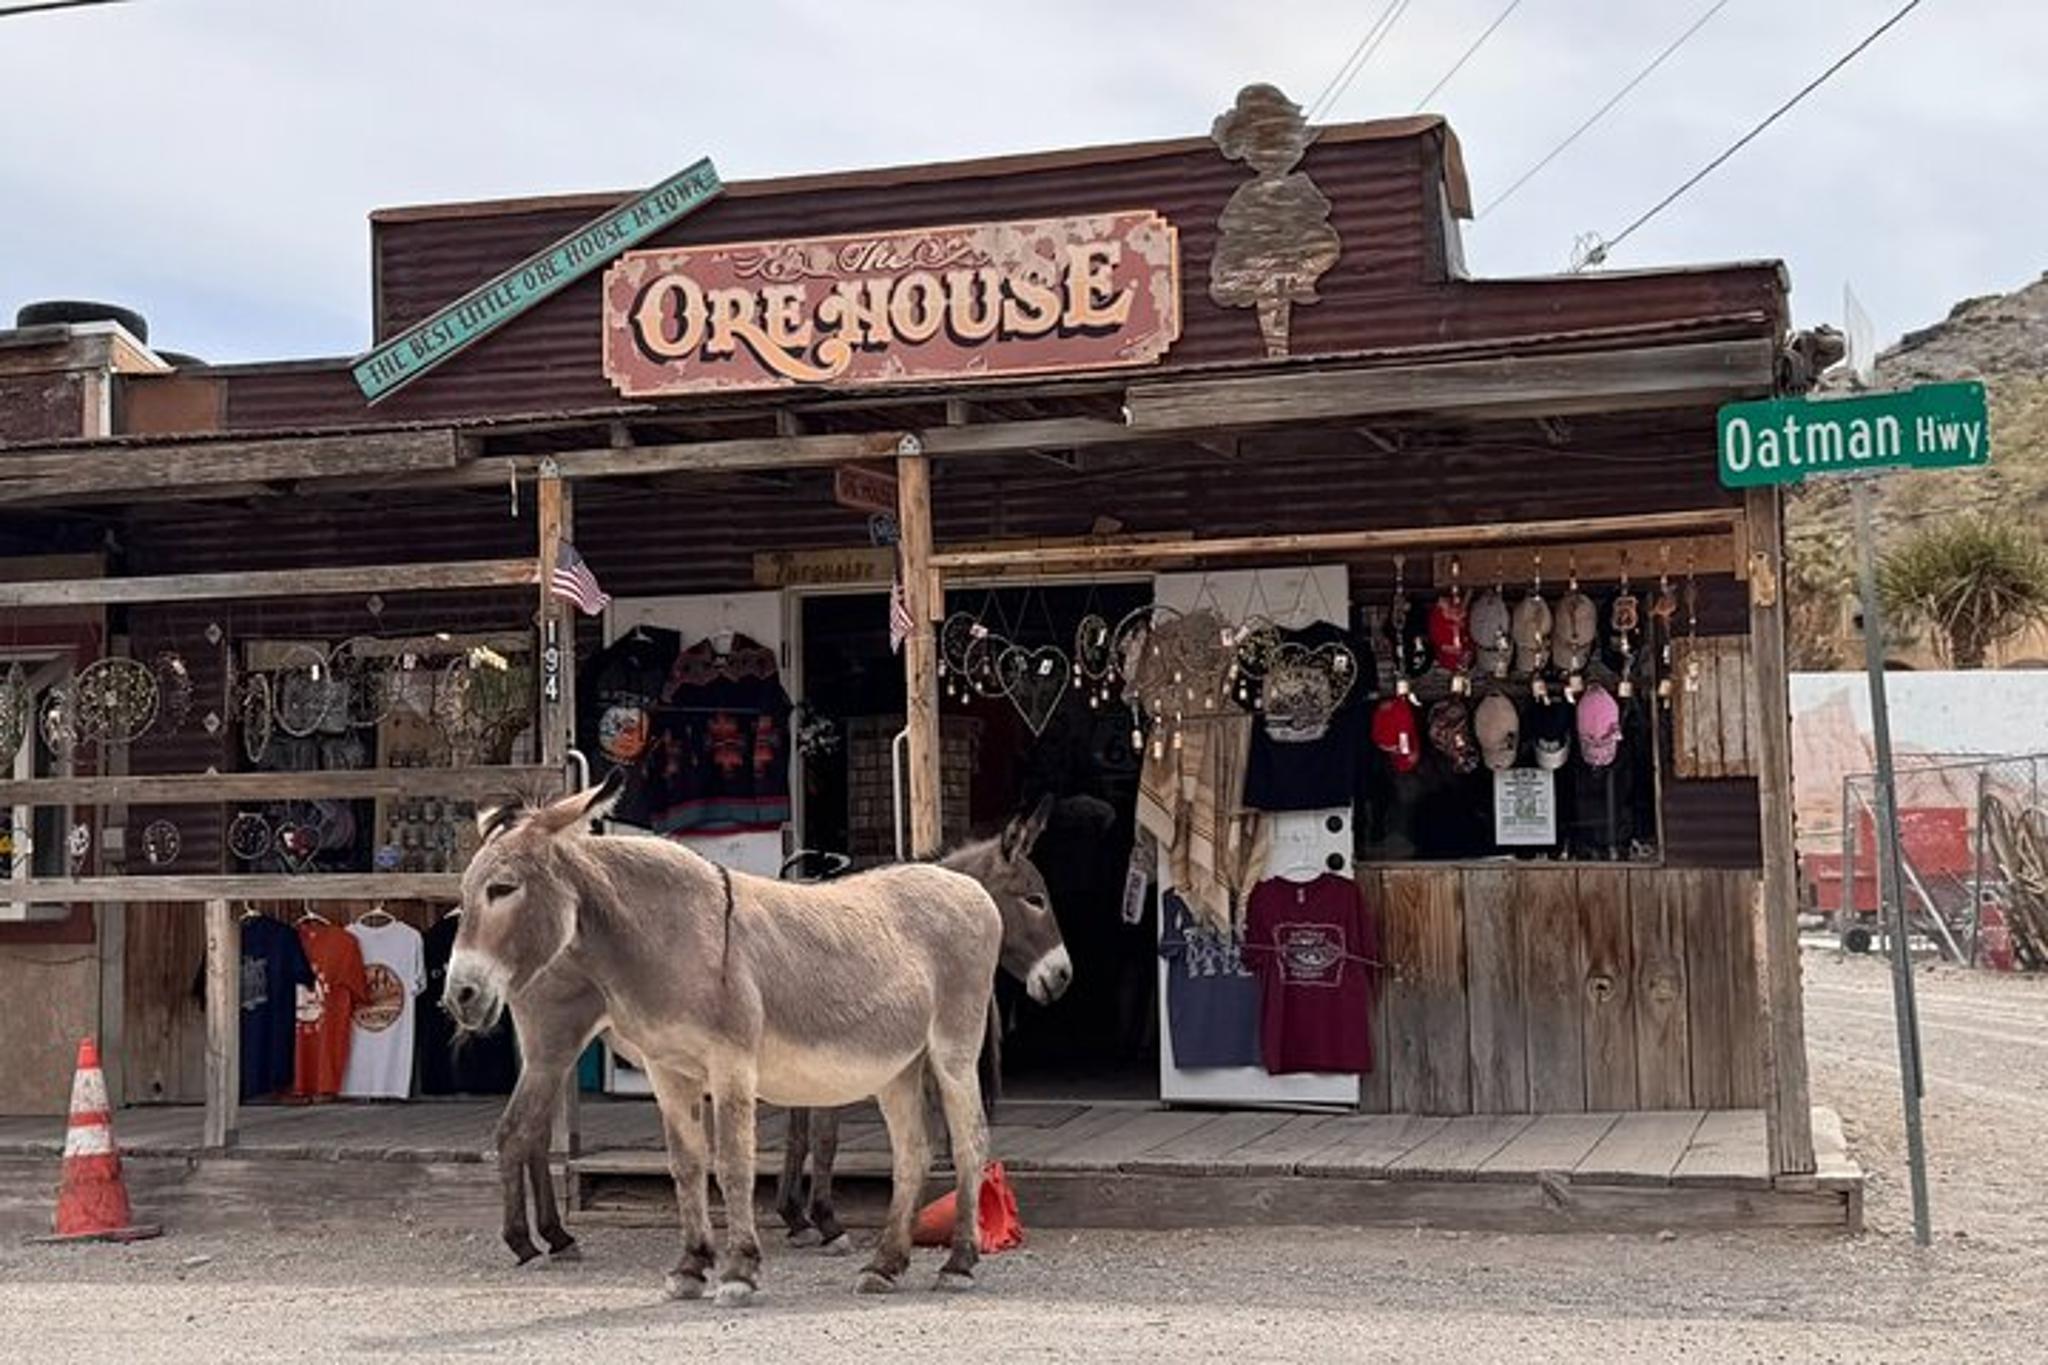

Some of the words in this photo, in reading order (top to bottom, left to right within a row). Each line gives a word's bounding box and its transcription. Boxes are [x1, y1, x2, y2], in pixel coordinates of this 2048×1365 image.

[367, 349, 408, 386] THE
[409, 322, 453, 360] BEST
[457, 284, 521, 334] LITTLE
[522, 255, 562, 291] ORE
[564, 218, 630, 268] HOUSE
[632, 203, 656, 228] IN
[655, 173, 709, 217] TOWN
[836, 239, 916, 273] The
[1725, 414, 1901, 473] Oatman
[1915, 416, 1981, 460] Hwy
[544, 620, 559, 701] 194
